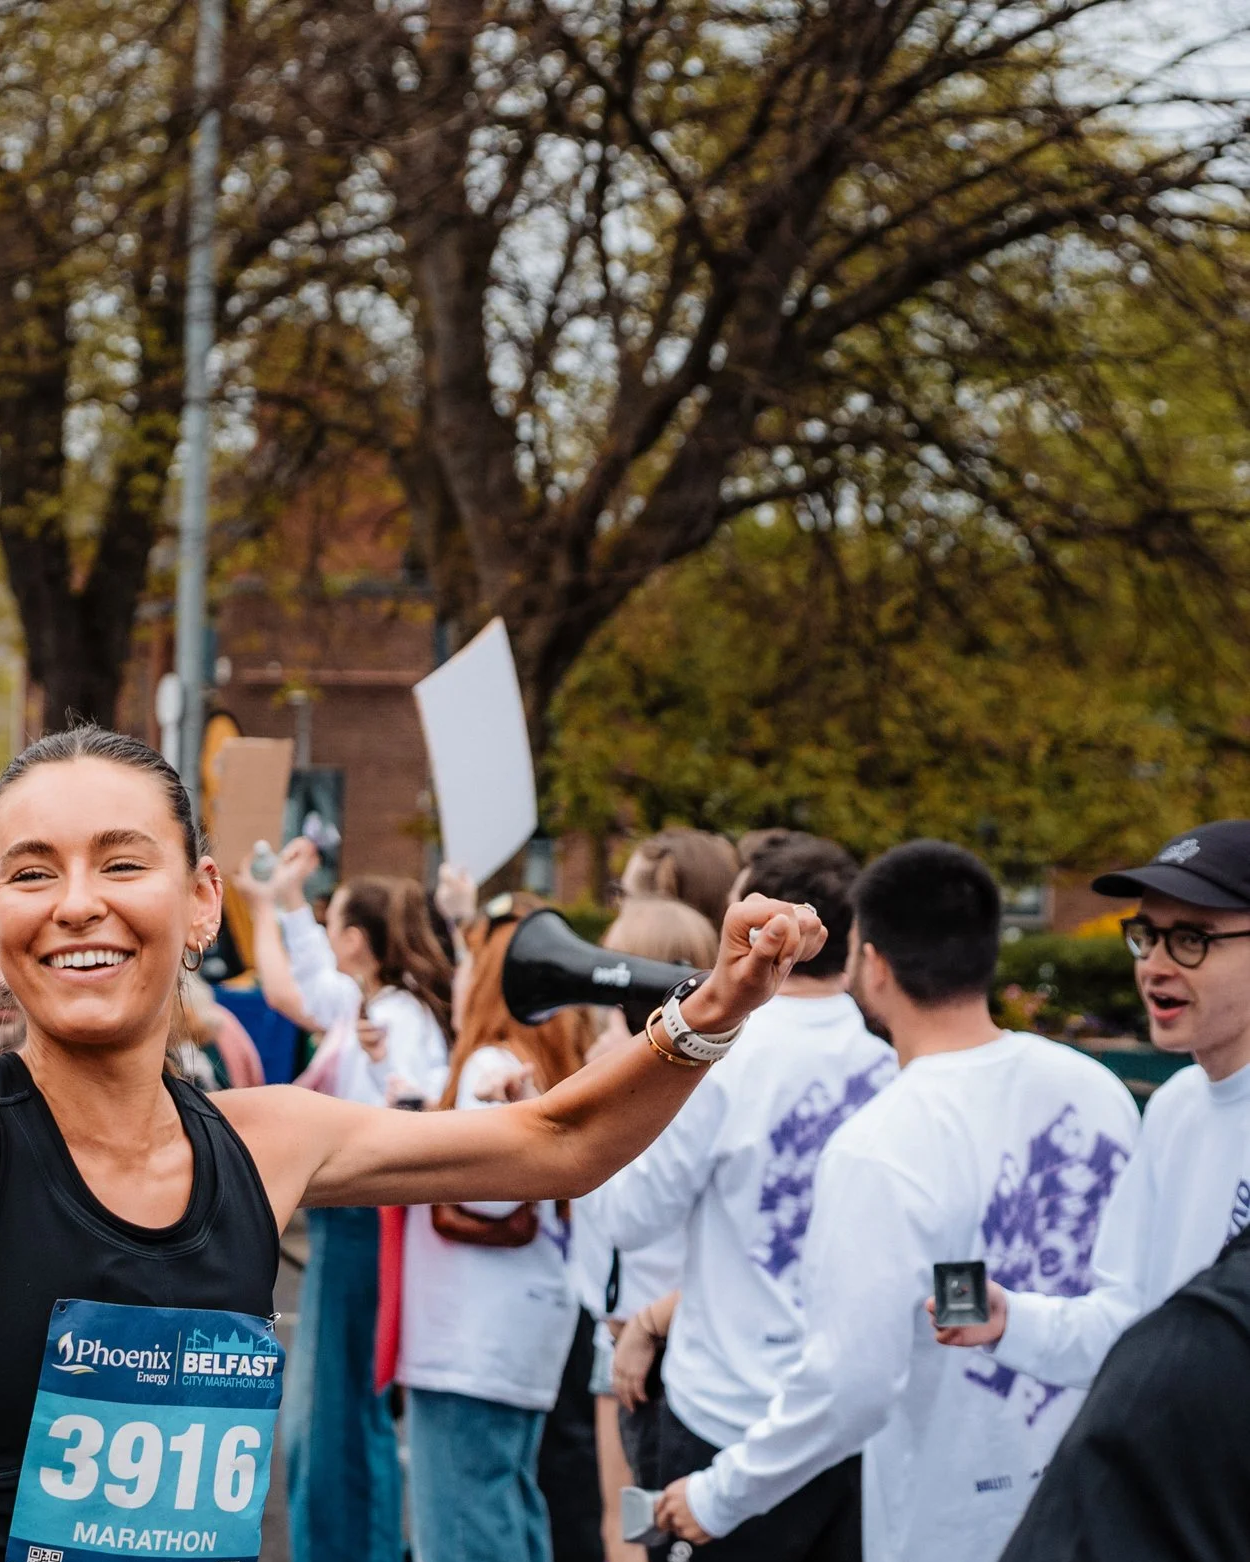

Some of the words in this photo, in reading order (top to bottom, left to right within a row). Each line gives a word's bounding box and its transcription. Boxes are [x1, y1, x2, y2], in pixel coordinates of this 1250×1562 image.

[75, 1339, 172, 1370] Phoenix
[182, 1352, 278, 1377] BELFAST
[136, 1371, 170, 1386] Energy
[182, 1376, 204, 1386] CITY
[204, 1376, 256, 1389] MARATHON
[257, 1379, 275, 1389] 2026
[38, 1414, 261, 1513] 3916
[72, 1521, 218, 1552] MARATHON
